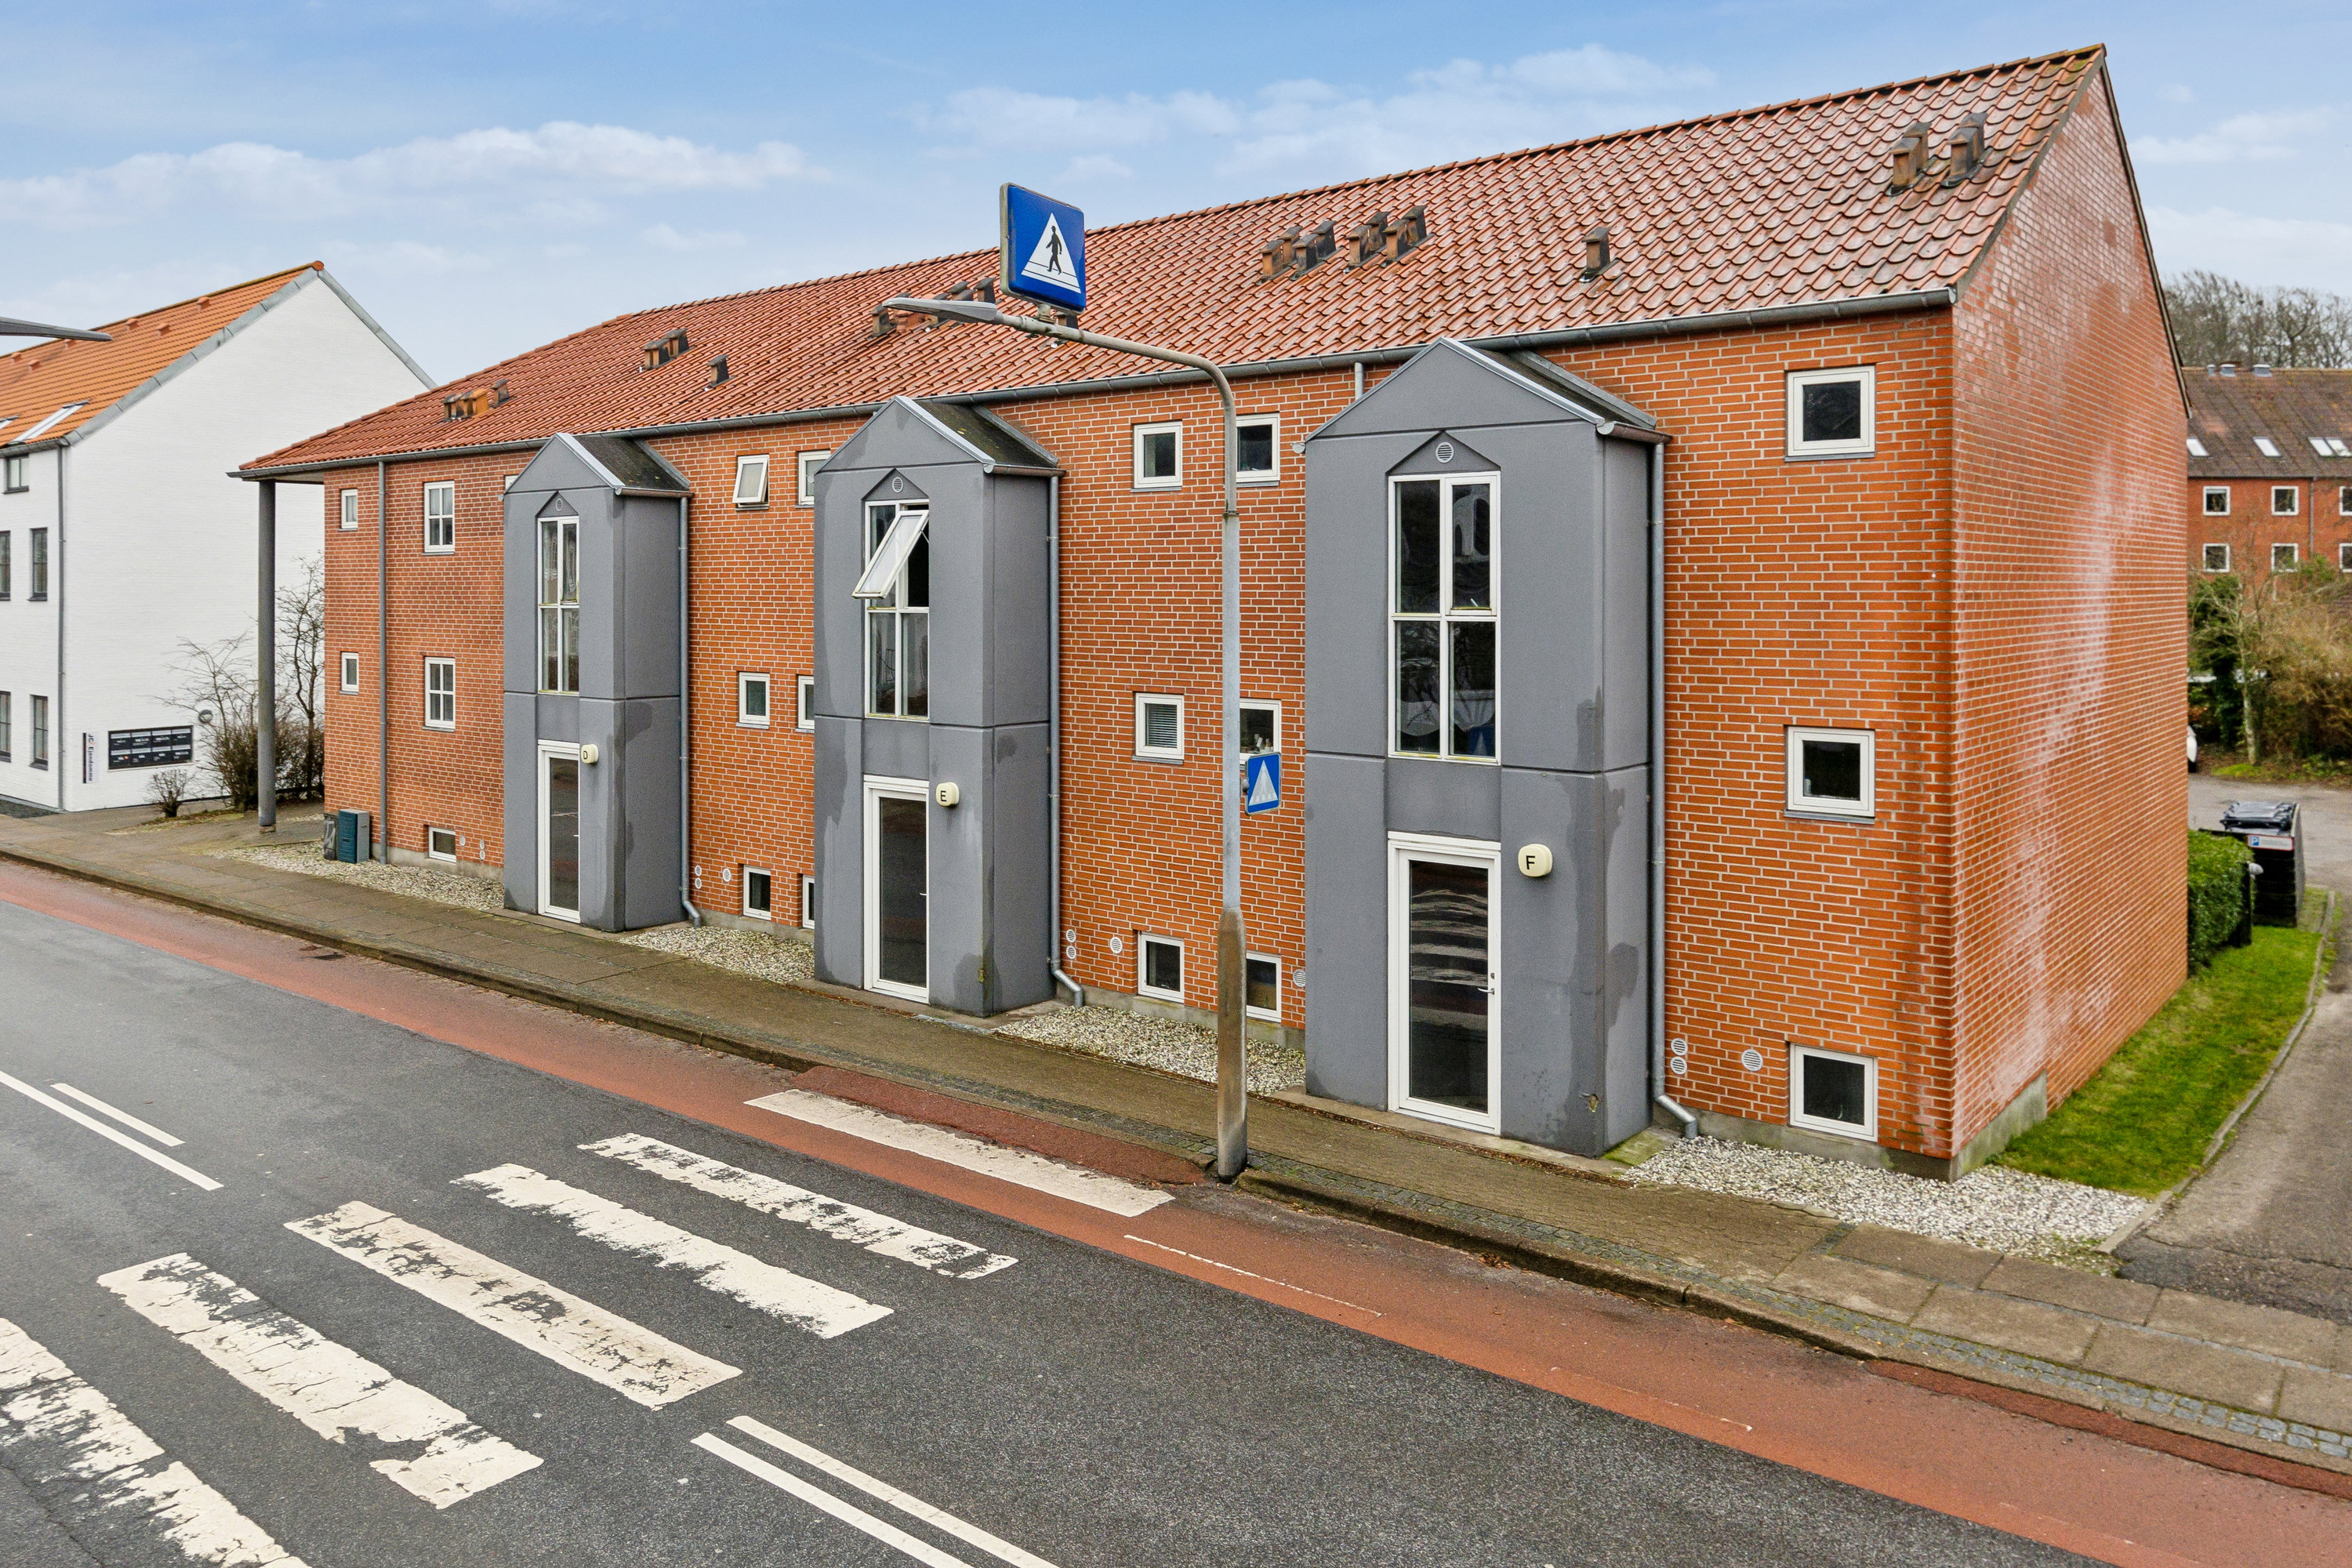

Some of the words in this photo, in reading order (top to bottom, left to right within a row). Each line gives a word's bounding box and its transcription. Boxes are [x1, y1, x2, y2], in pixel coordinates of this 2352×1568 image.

[583, 750, 588, 760] D
[940, 790, 947, 802] E
[1526, 855, 1536, 870] F
